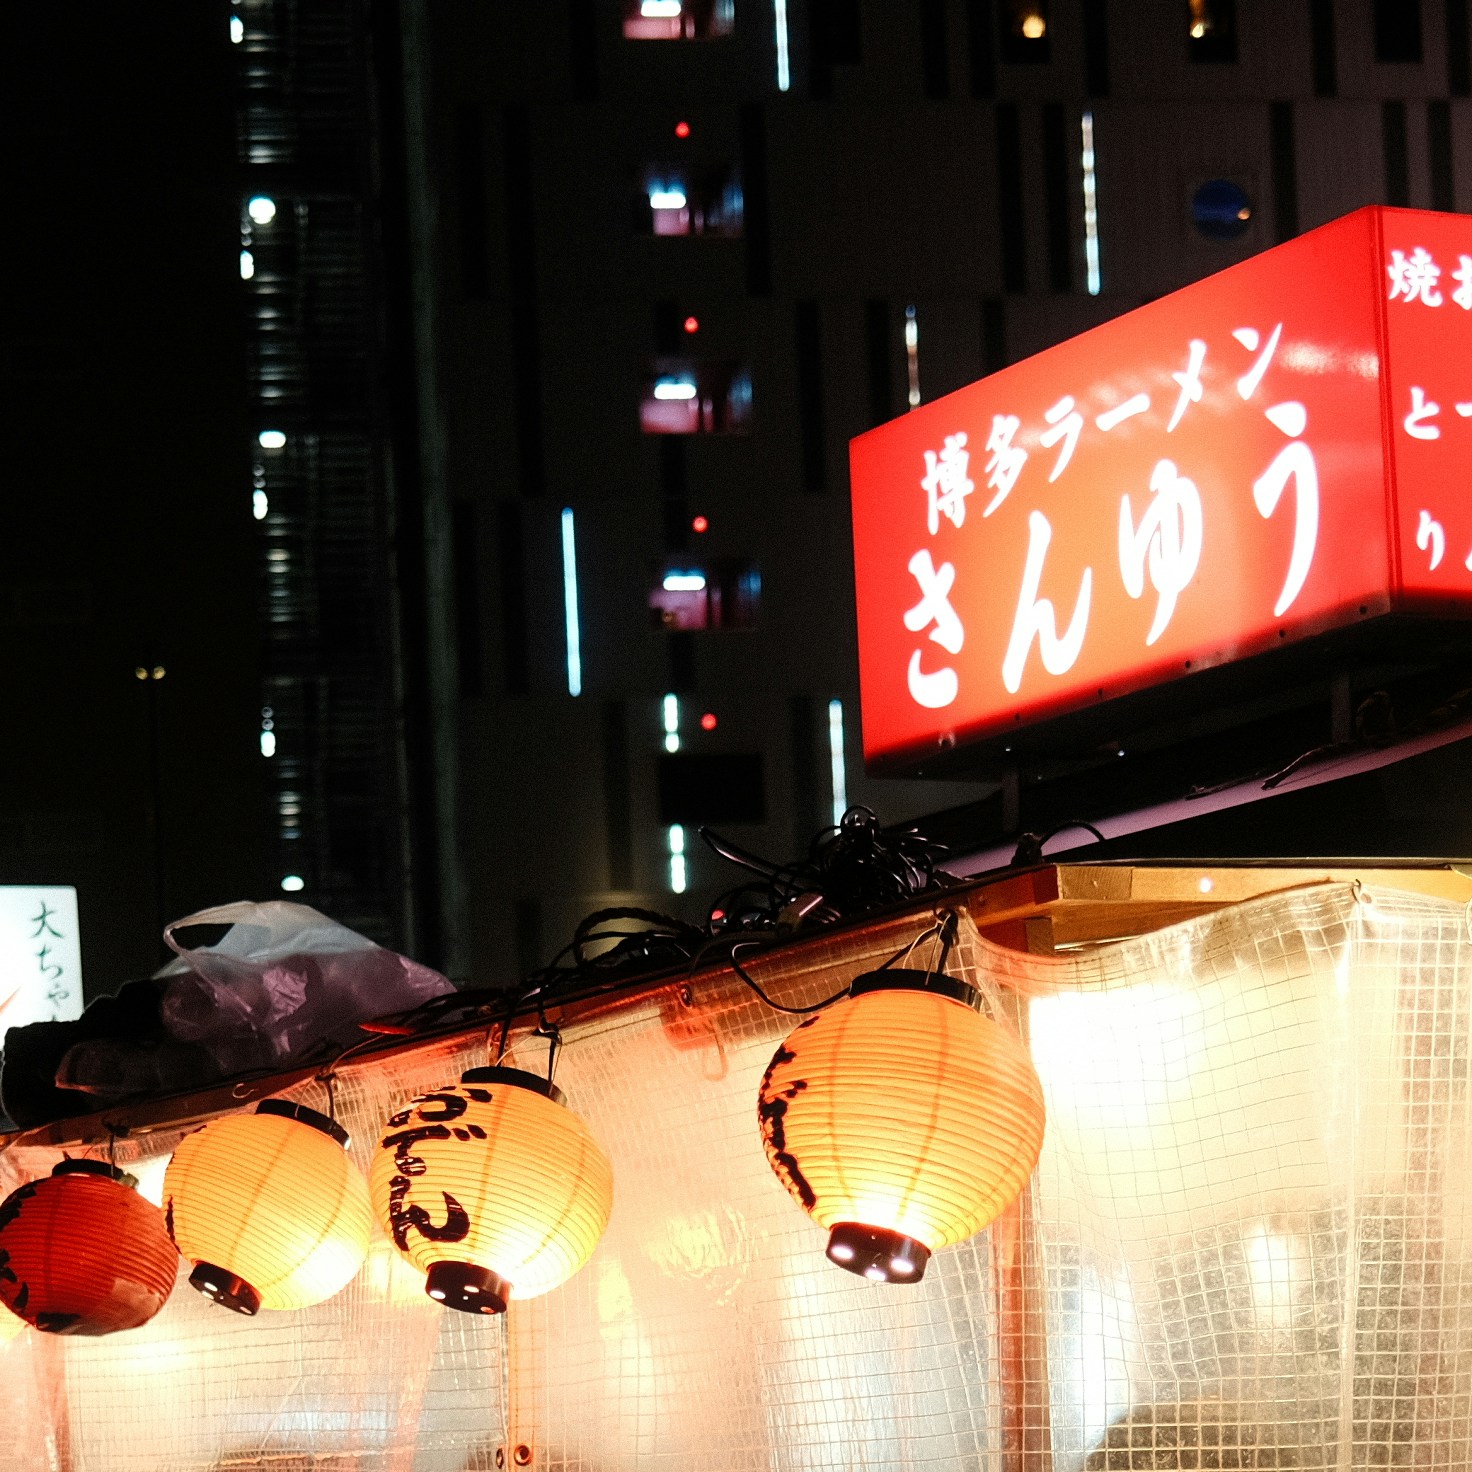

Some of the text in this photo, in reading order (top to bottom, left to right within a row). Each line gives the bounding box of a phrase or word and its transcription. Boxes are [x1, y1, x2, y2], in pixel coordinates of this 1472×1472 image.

[921, 322, 1283, 535] 博多ラーメン
[1387, 247, 1446, 572] 焼とり
[903, 401, 1320, 709] さんゆう
[31, 901, 71, 1024] 大ちゃ
